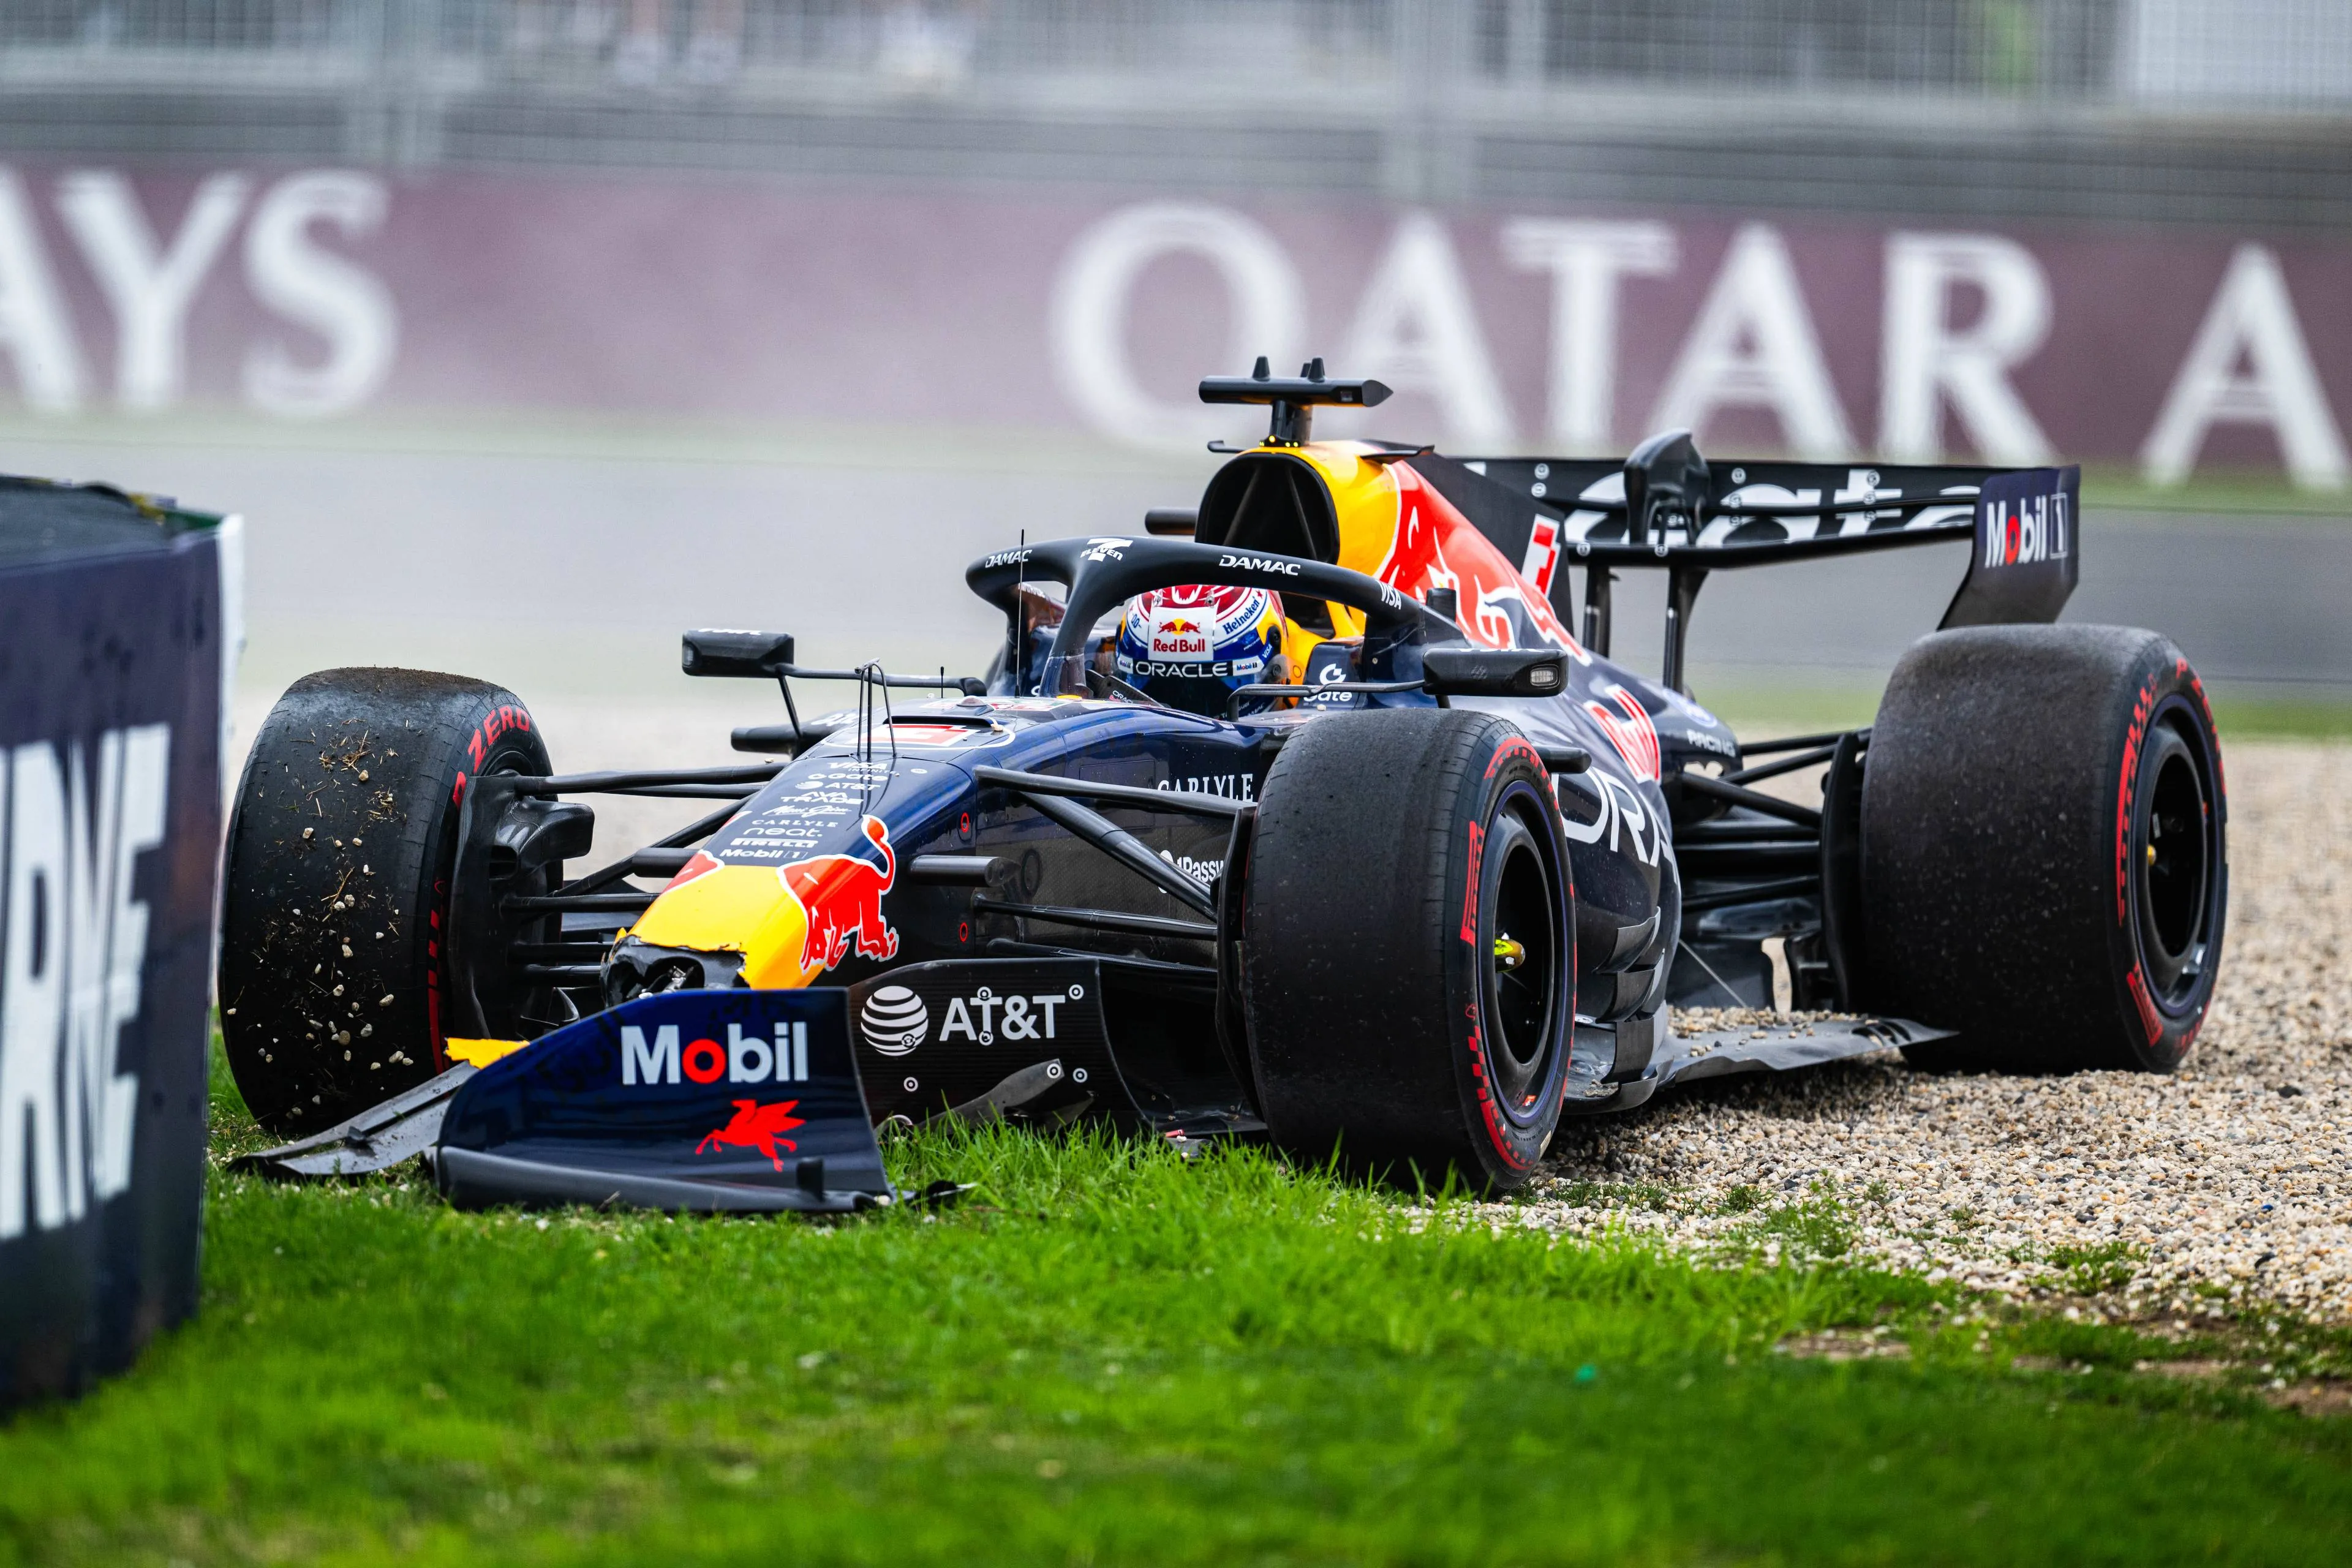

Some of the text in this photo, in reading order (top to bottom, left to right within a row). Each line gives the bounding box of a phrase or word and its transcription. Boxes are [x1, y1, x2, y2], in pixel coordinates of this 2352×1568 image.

[1985, 496, 2066, 568] Mobil 1
[985, 549, 1033, 568] DAMAC
[1087, 538, 1133, 562] 7
[1219, 555, 1301, 576] DAMAC
[1376, 579, 1402, 610] VISA
[1223, 600, 1259, 635] Heineken
[1153, 639, 1205, 652] Red Bull
[1262, 643, 1272, 658] VISA
[1136, 662, 1228, 677] ORACLE
[468, 705, 530, 774] ZERO
[719, 849, 784, 858] Mobil
[730, 838, 818, 848] PIRELLI
[0, 723, 170, 1238] RNE
[939, 992, 1066, 1045] AT&T
[621, 1022, 809, 1085] Mobil
